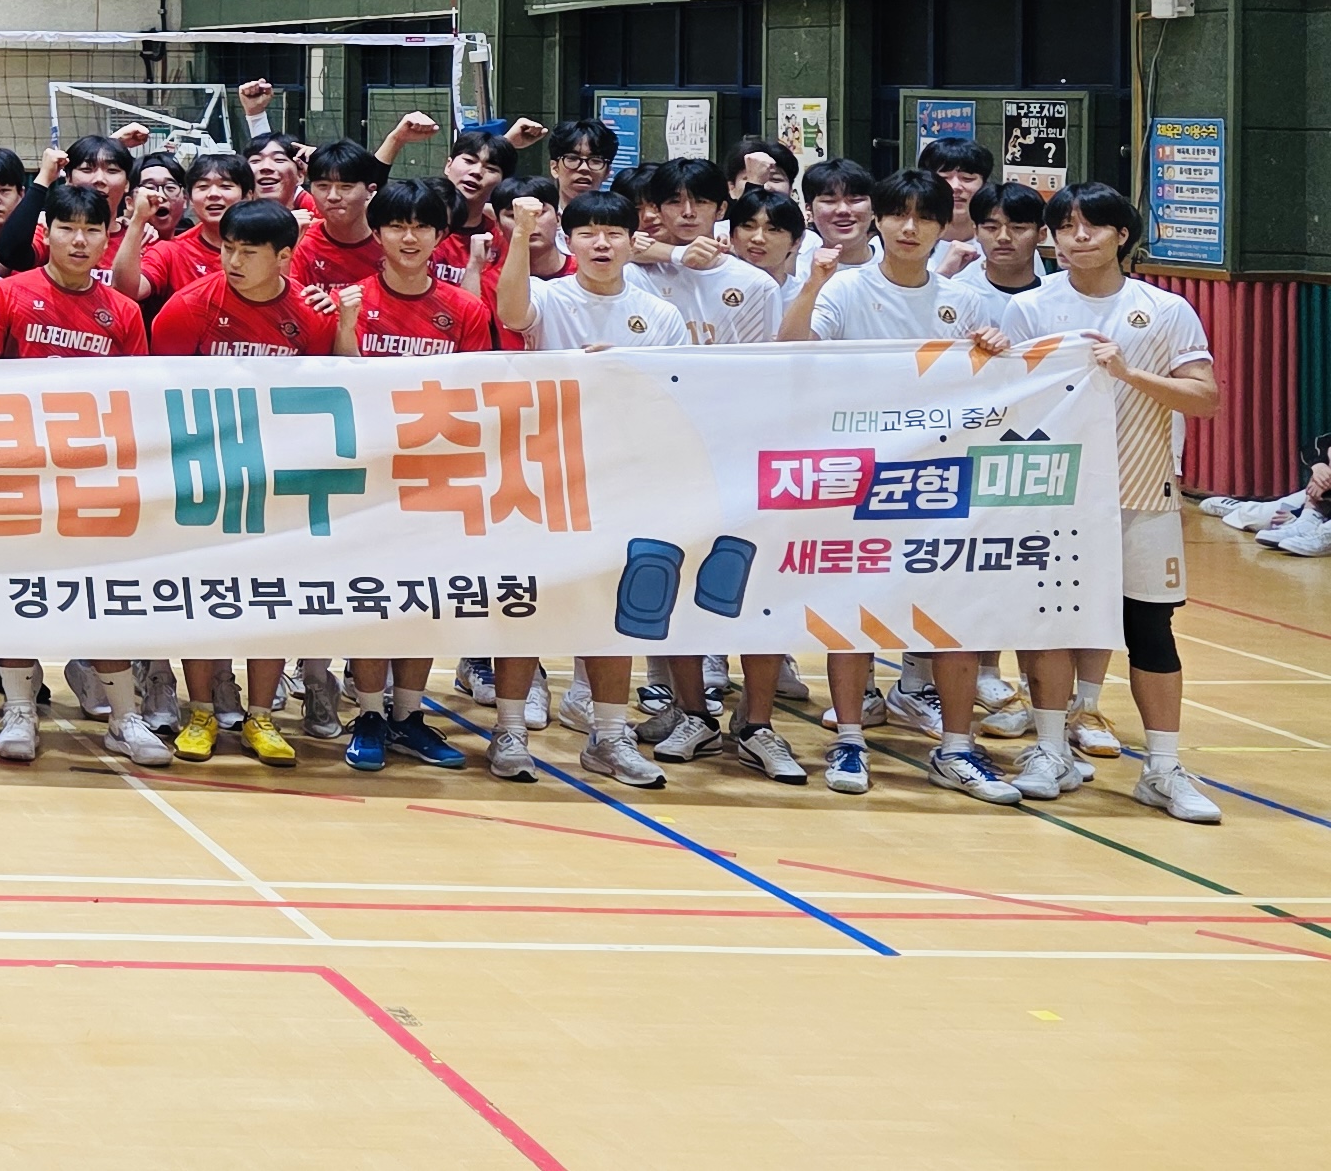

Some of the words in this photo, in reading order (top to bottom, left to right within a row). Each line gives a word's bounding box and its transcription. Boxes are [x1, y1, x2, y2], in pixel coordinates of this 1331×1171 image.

[1043, 142, 1056, 164] ?
[1157, 167, 1163, 177] 2
[1157, 186, 1163, 197] 3
[25, 324, 113, 356] UIJEONGBU
[832, 407, 952, 433] 미래교육의
[961, 406, 1008, 429] 중심
[164, 386, 367, 536] 배구
[391, 379, 593, 536] 축제
[770, 455, 862, 501] 자율
[869, 465, 959, 512] 균형
[977, 453, 1070, 497] 미래
[778, 538, 892, 575] 새로운
[902, 535, 1051, 573] 경기교육
[1165, 557, 1180, 588] 9
[9, 575, 538, 620] 경기도의정부교육지원청
